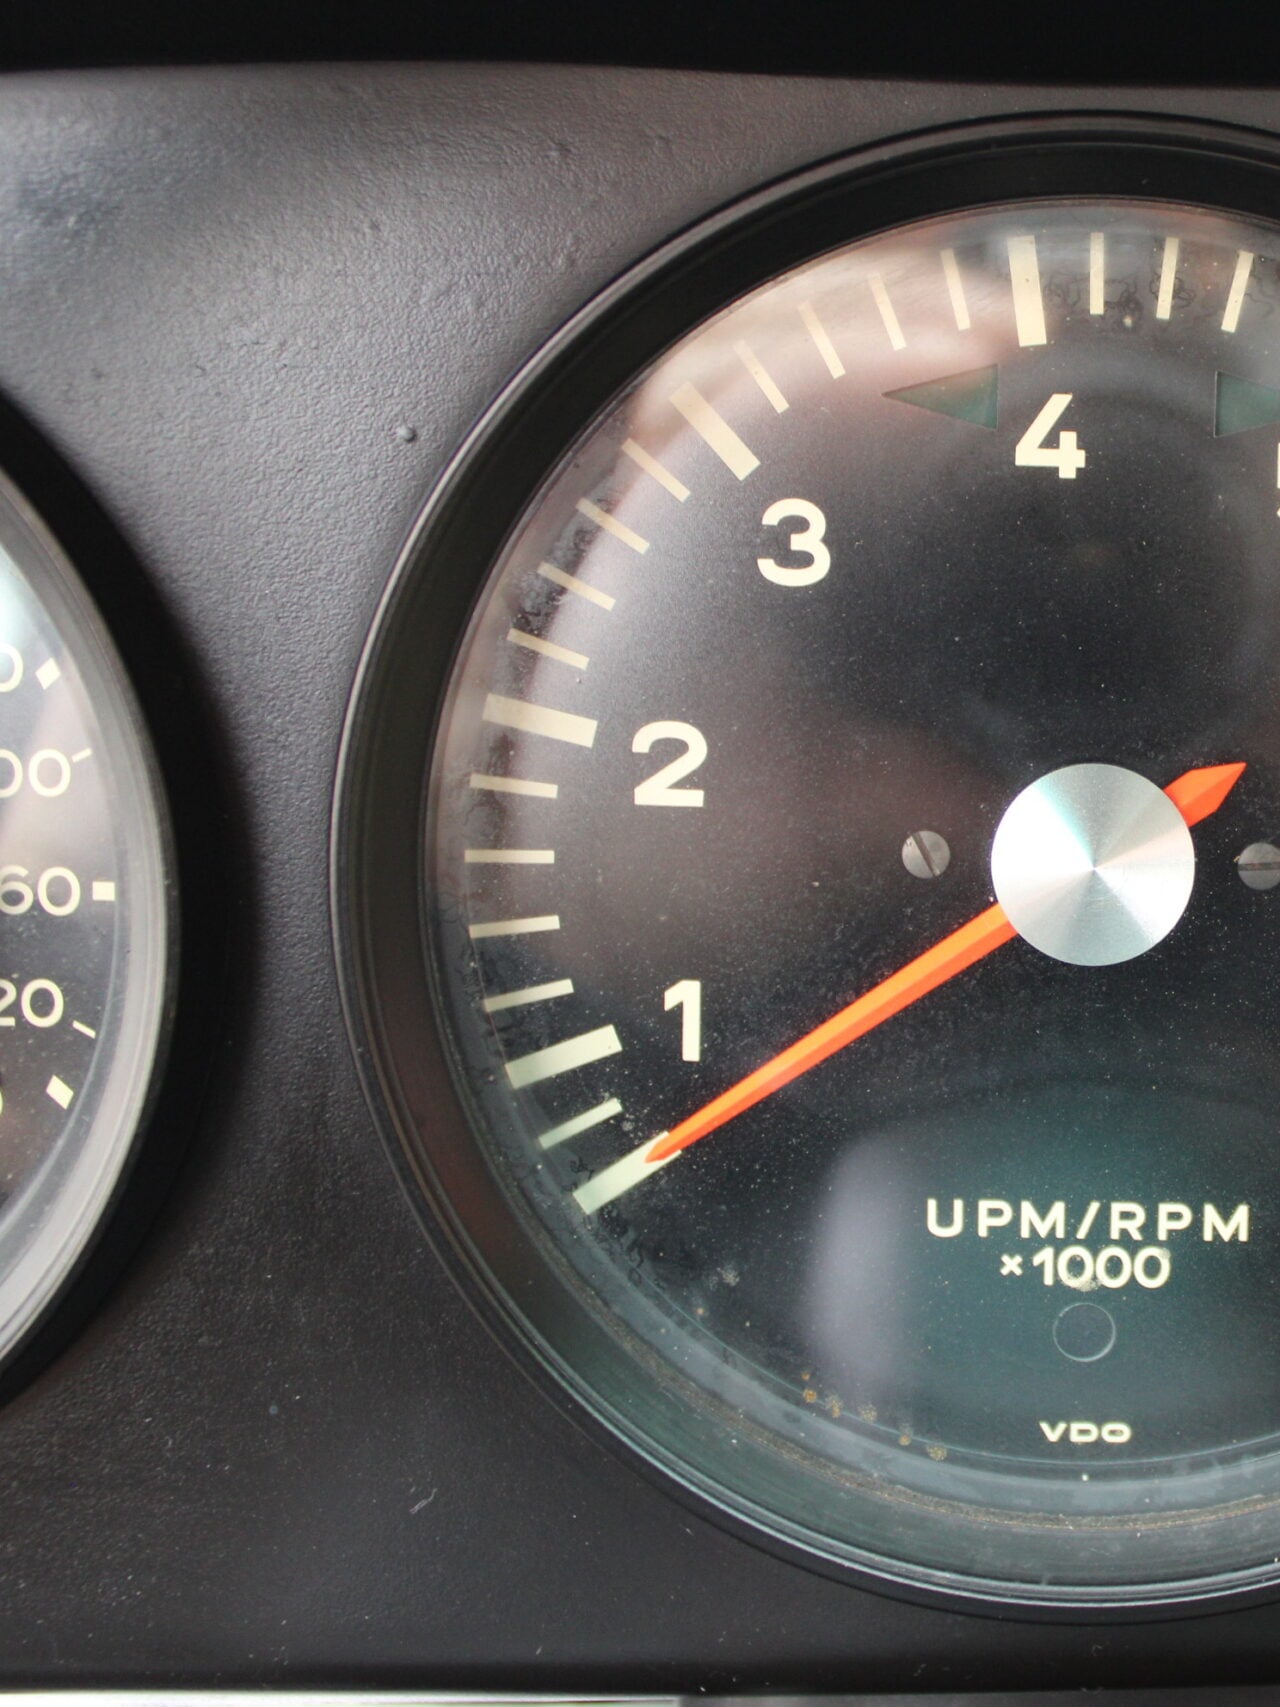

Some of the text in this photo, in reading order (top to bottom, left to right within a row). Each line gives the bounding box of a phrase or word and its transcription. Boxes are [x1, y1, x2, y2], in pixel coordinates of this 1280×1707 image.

[1014, 393, 1086, 479] 4
[756, 497, 831, 587] 3
[632, 720, 708, 808] 2
[0, 865, 81, 916] 60
[663, 979, 702, 1062] 1
[926, 1198, 1250, 1242] UPM/RPM
[1039, 1421, 1132, 1444] VDO
